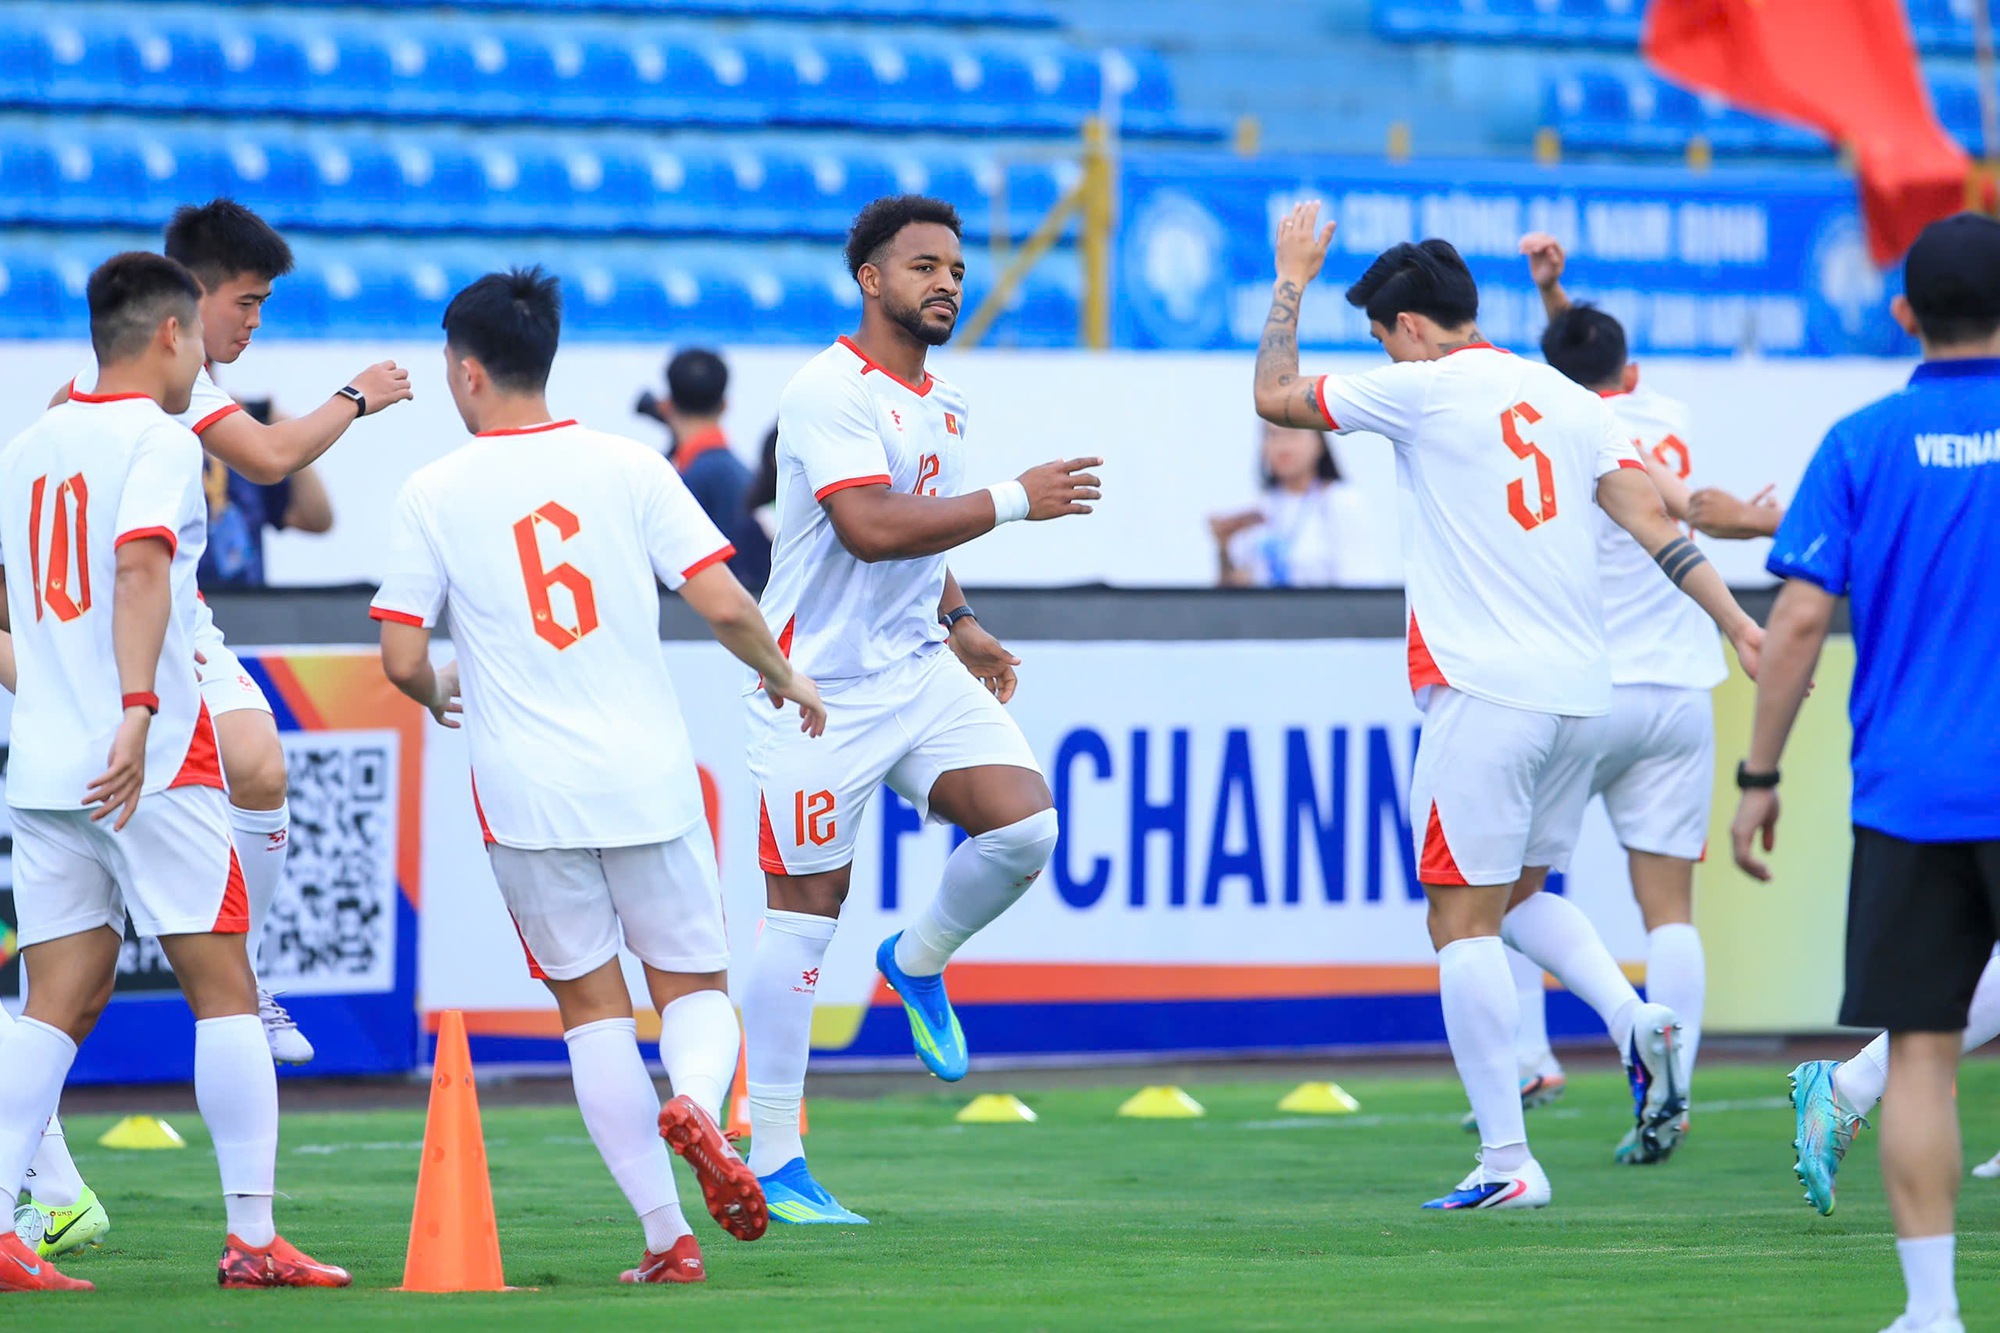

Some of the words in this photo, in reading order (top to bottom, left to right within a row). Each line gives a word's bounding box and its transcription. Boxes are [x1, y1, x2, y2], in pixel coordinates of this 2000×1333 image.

[912, 453, 940, 497] 12
[1499, 400, 1558, 532] 5
[1914, 428, 2000, 468] VIETNA
[28, 471, 92, 624] 10
[512, 499, 601, 652] 6
[794, 788, 836, 848] 12
[1052, 725, 1566, 912] CHANN
